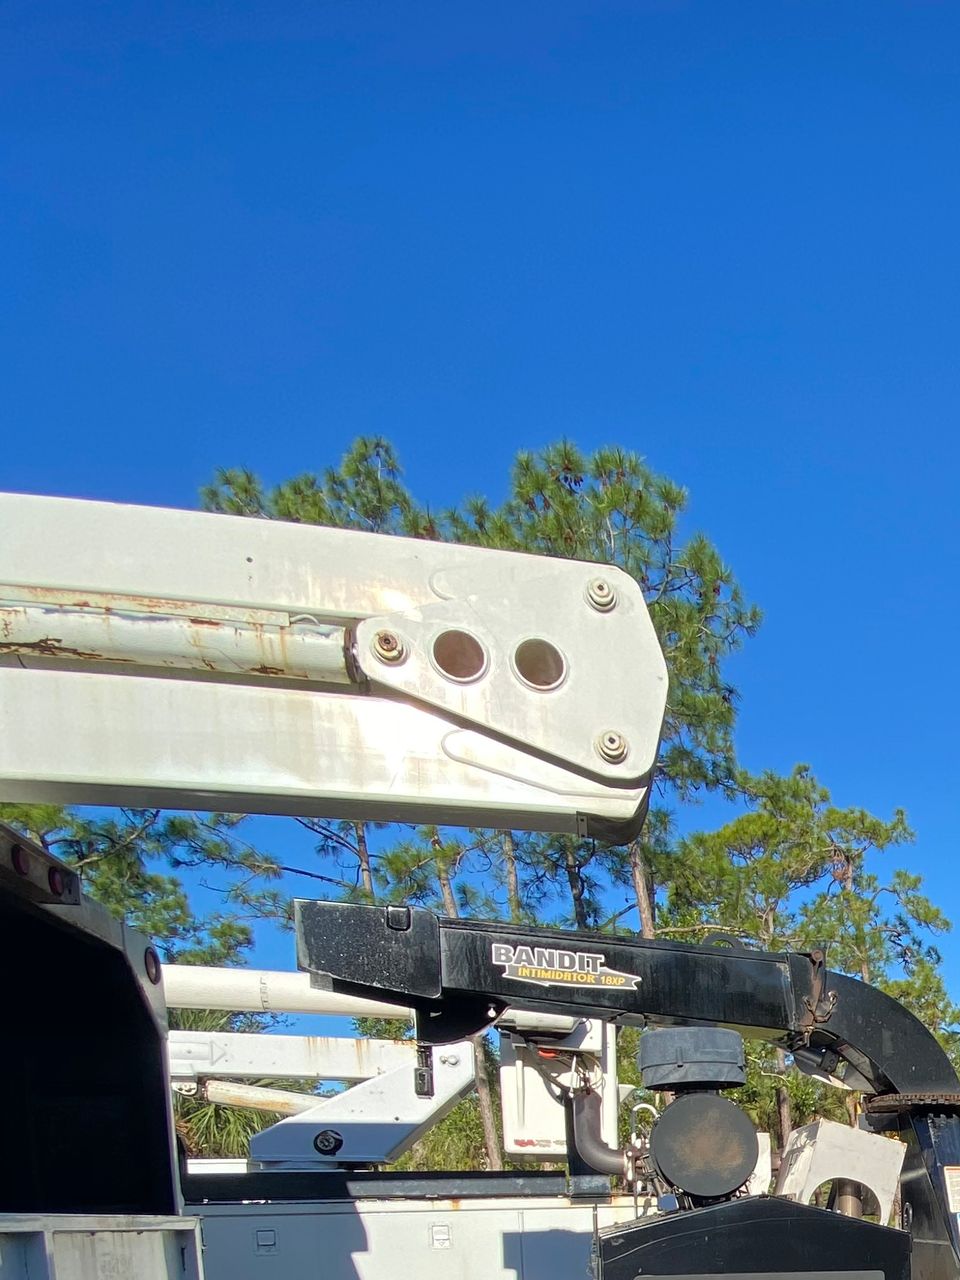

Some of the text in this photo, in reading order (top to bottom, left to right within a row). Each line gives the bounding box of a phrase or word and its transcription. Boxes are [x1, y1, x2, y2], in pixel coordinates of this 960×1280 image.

[493, 944, 604, 974] BANDIT
[517, 967, 626, 986] INTIMIDATOR 18XP
